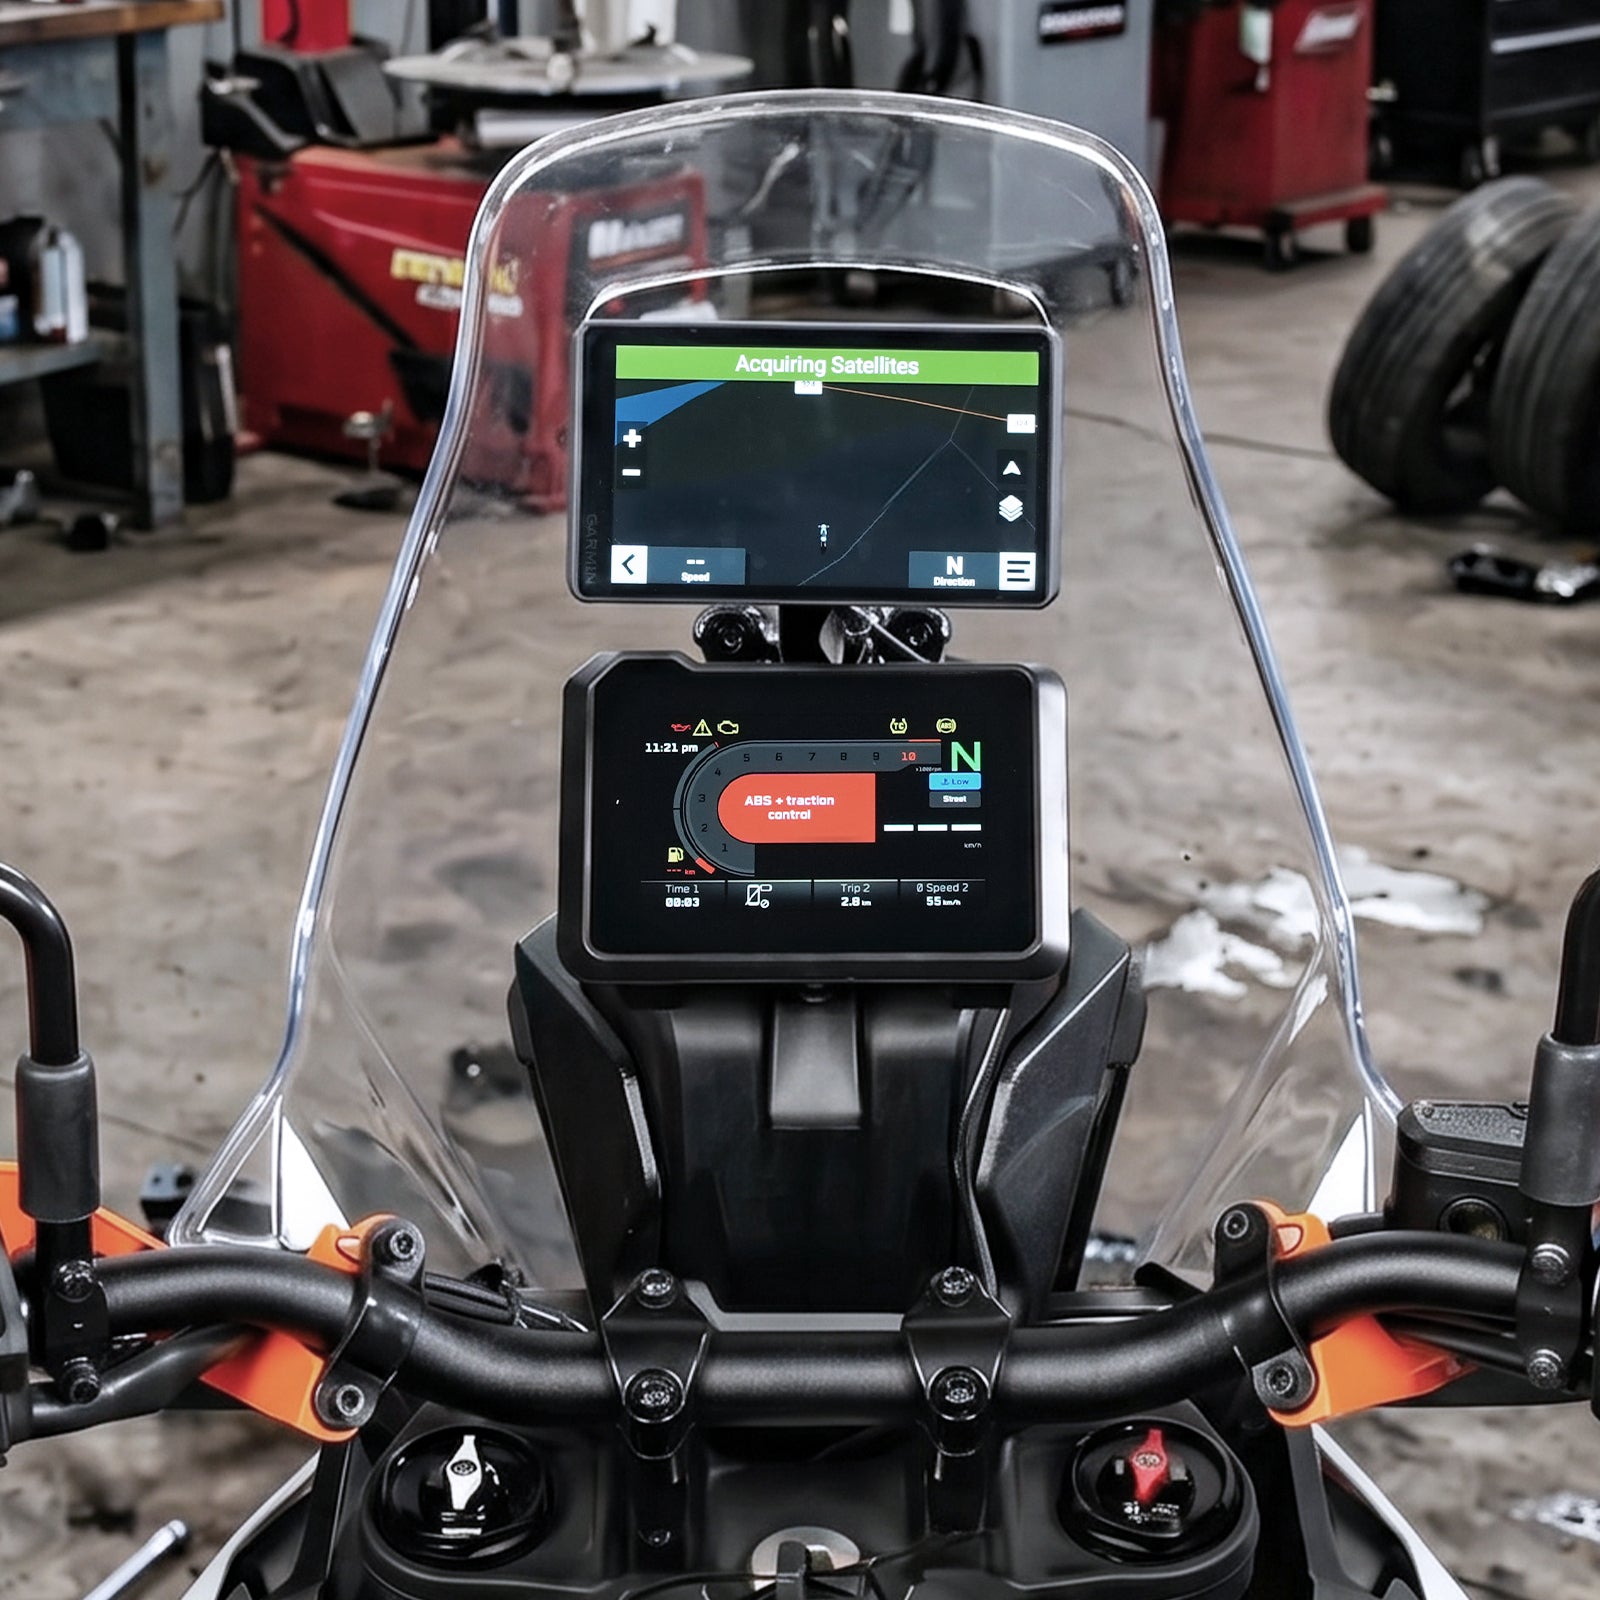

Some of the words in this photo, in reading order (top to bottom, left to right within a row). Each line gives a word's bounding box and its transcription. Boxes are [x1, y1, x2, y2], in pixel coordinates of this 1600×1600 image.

[735, 354, 826, 378] Acquiring
[831, 356, 919, 375] Satellites
[585, 513, 598, 585] GARMIN
[946, 556, 964, 575] N
[681, 571, 711, 583] Speed
[933, 577, 976, 587] Direction
[894, 722, 904, 730] TC
[645, 743, 679, 752] 11:21
[682, 744, 698, 754] pm
[743, 753, 750, 762] 5
[775, 752, 783, 761] 6
[808, 752, 816, 761] 7
[840, 752, 847, 761] 8
[872, 752, 880, 761] 9
[901, 752, 917, 761] 10
[951, 741, 981, 772] N
[714, 768, 722, 777] 4
[951, 778, 970, 786] Low
[698, 793, 706, 802] 3
[744, 795, 772, 806] ABS
[786, 795, 835, 806] traction
[942, 795, 968, 803] Street
[767, 810, 811, 820] control
[701, 823, 709, 832] 2
[721, 843, 729, 852] 1
[665, 884, 691, 894] Time
[693, 884, 700, 894] 1
[840, 883, 861, 894] Trip
[863, 883, 871, 893] 2
[926, 883, 960, 894] Speed
[962, 883, 969, 893] 2
[665, 897, 700, 908] 00:03
[840, 896, 861, 907] 2.8
[926, 896, 942, 906] 55
